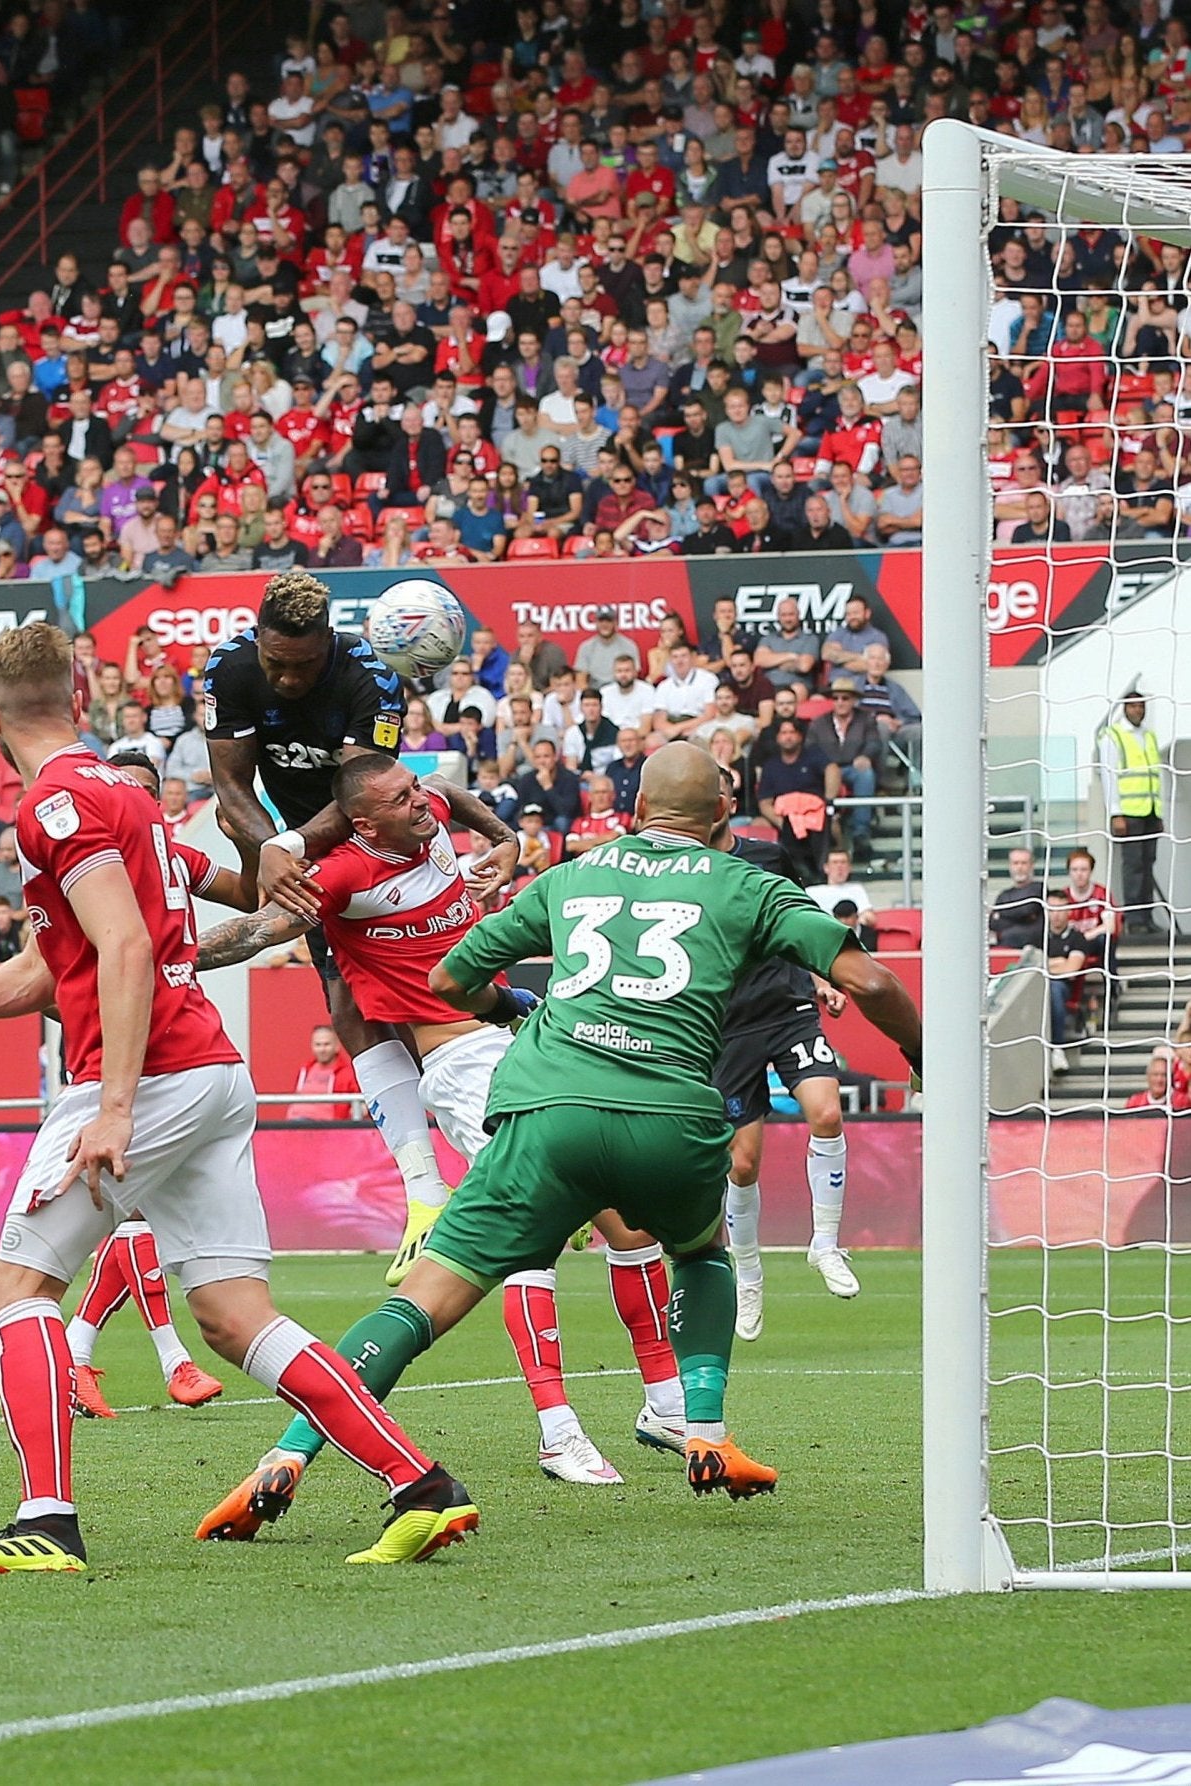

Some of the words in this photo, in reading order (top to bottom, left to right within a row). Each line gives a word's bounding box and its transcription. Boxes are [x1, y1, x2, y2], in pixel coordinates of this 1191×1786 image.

[511, 597, 668, 632] THATCERS
[734, 582, 853, 622] ETM
[986, 580, 1039, 630] ge
[147, 607, 258, 647] sage
[577, 846, 711, 878] MAENPAA
[151, 823, 196, 945] 4
[550, 895, 703, 1001] 33
[574, 1021, 629, 1041] Poplar
[790, 1035, 835, 1070] 16
[670, 1288, 685, 1332] CITY
[352, 1340, 381, 1371] CIT
